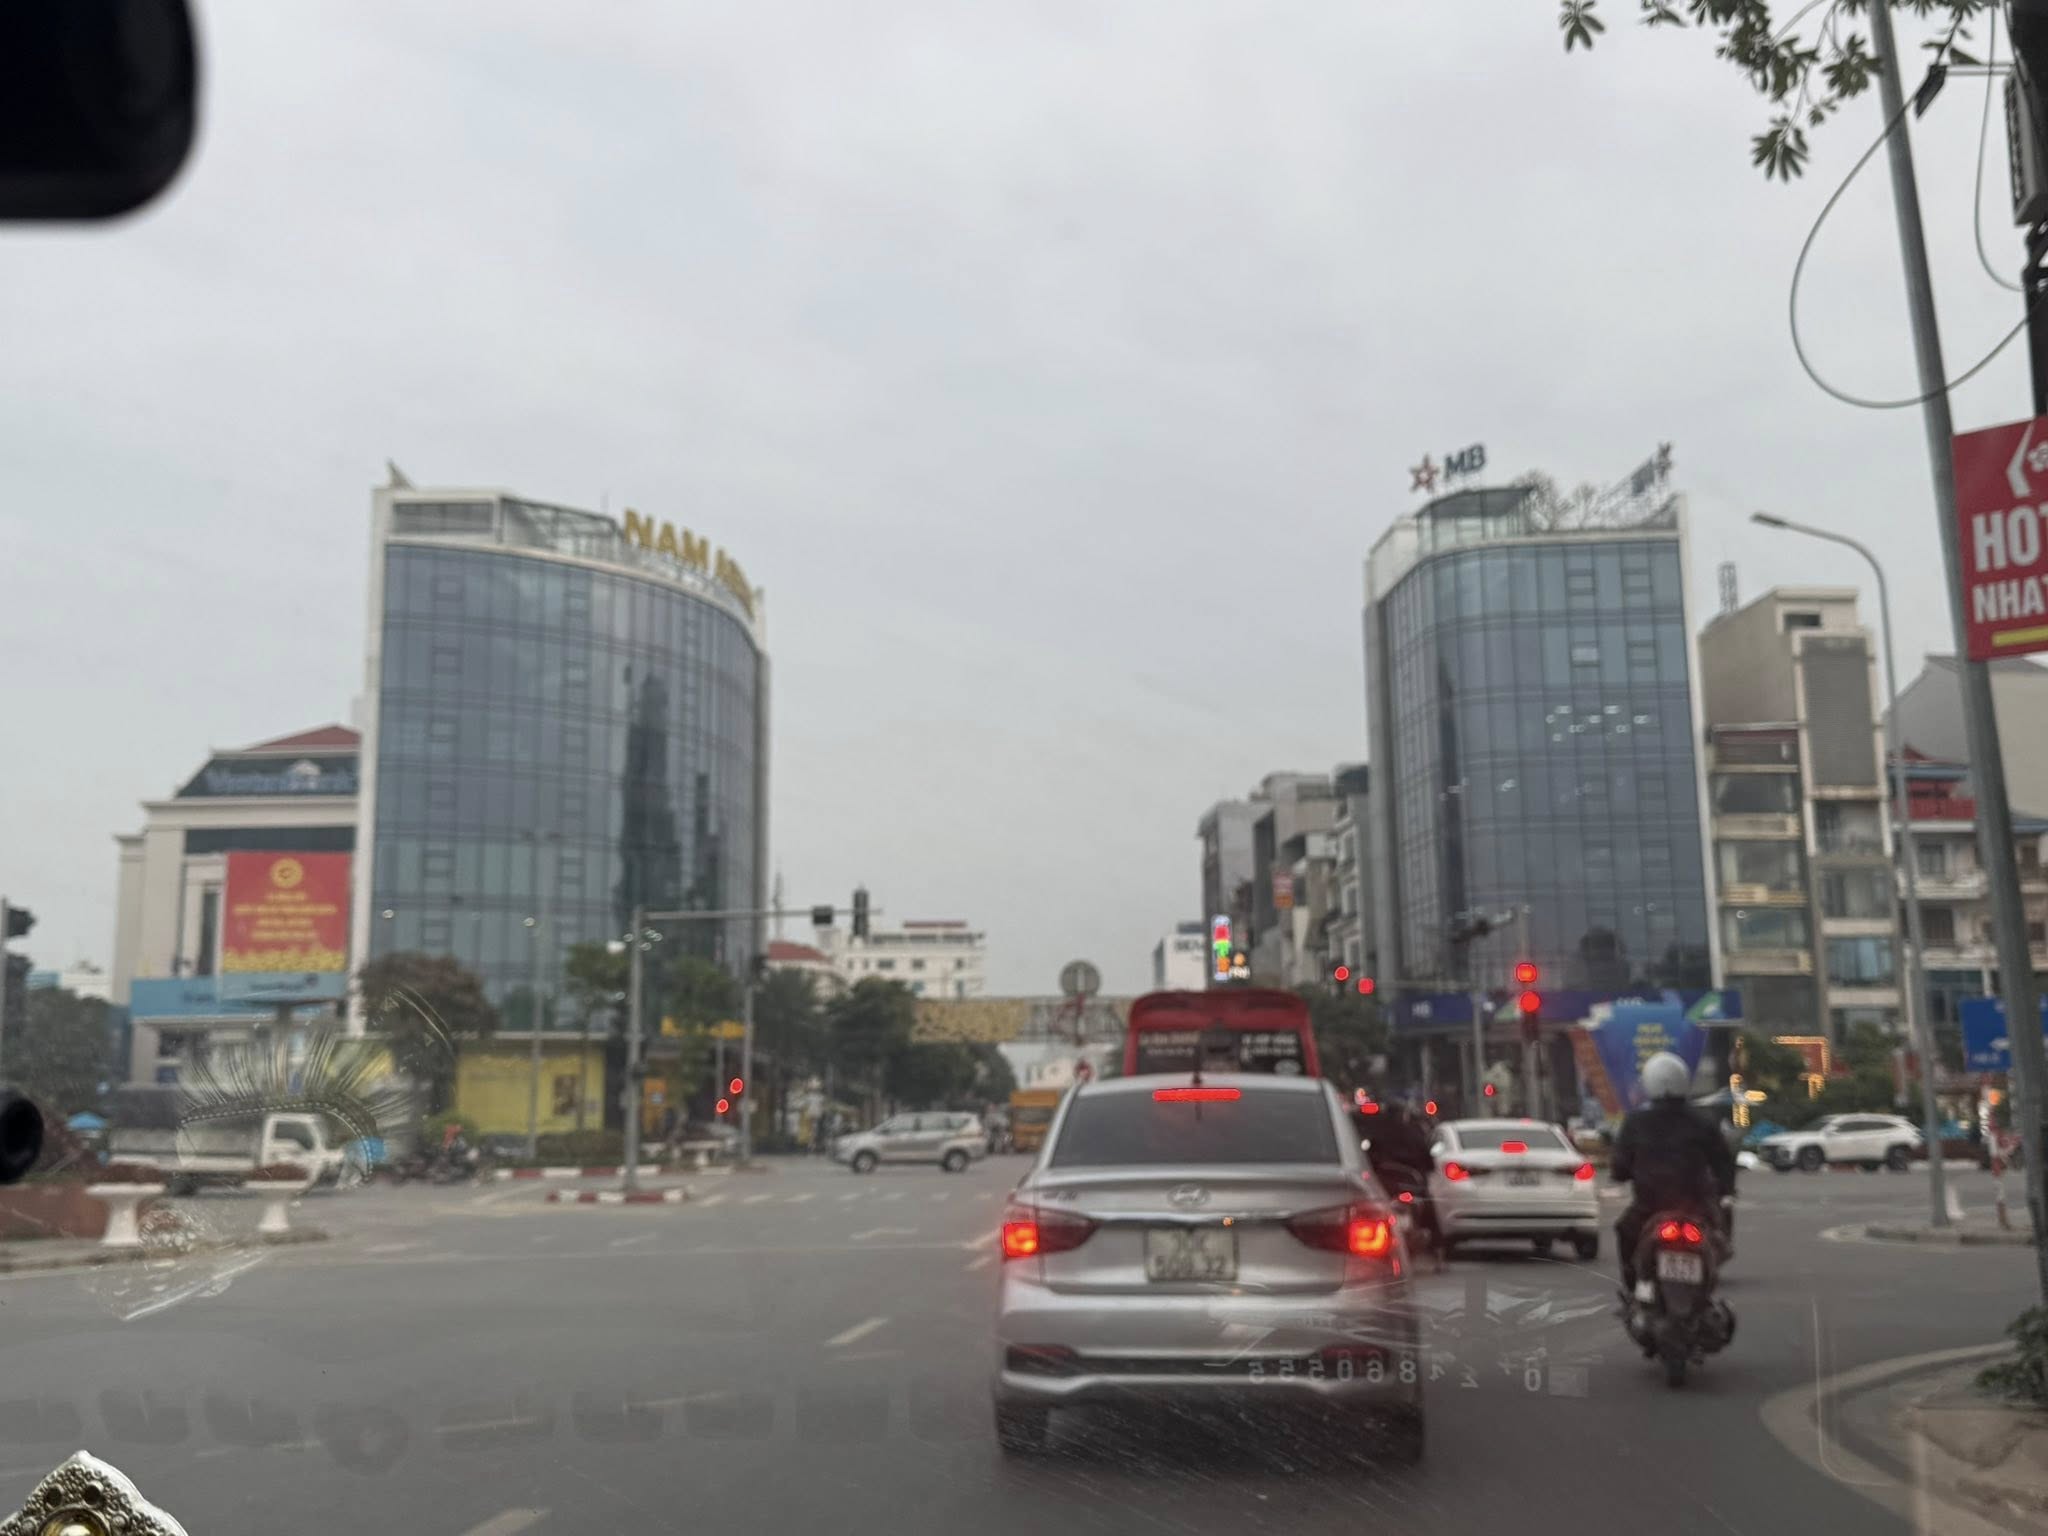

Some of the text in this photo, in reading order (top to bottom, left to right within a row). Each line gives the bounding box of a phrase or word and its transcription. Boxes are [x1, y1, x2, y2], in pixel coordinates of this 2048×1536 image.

[1444, 443, 1485, 480] MB
[624, 508, 709, 572] NAM
[1972, 502, 2048, 573] HO
[1972, 574, 2048, 624] NHA
